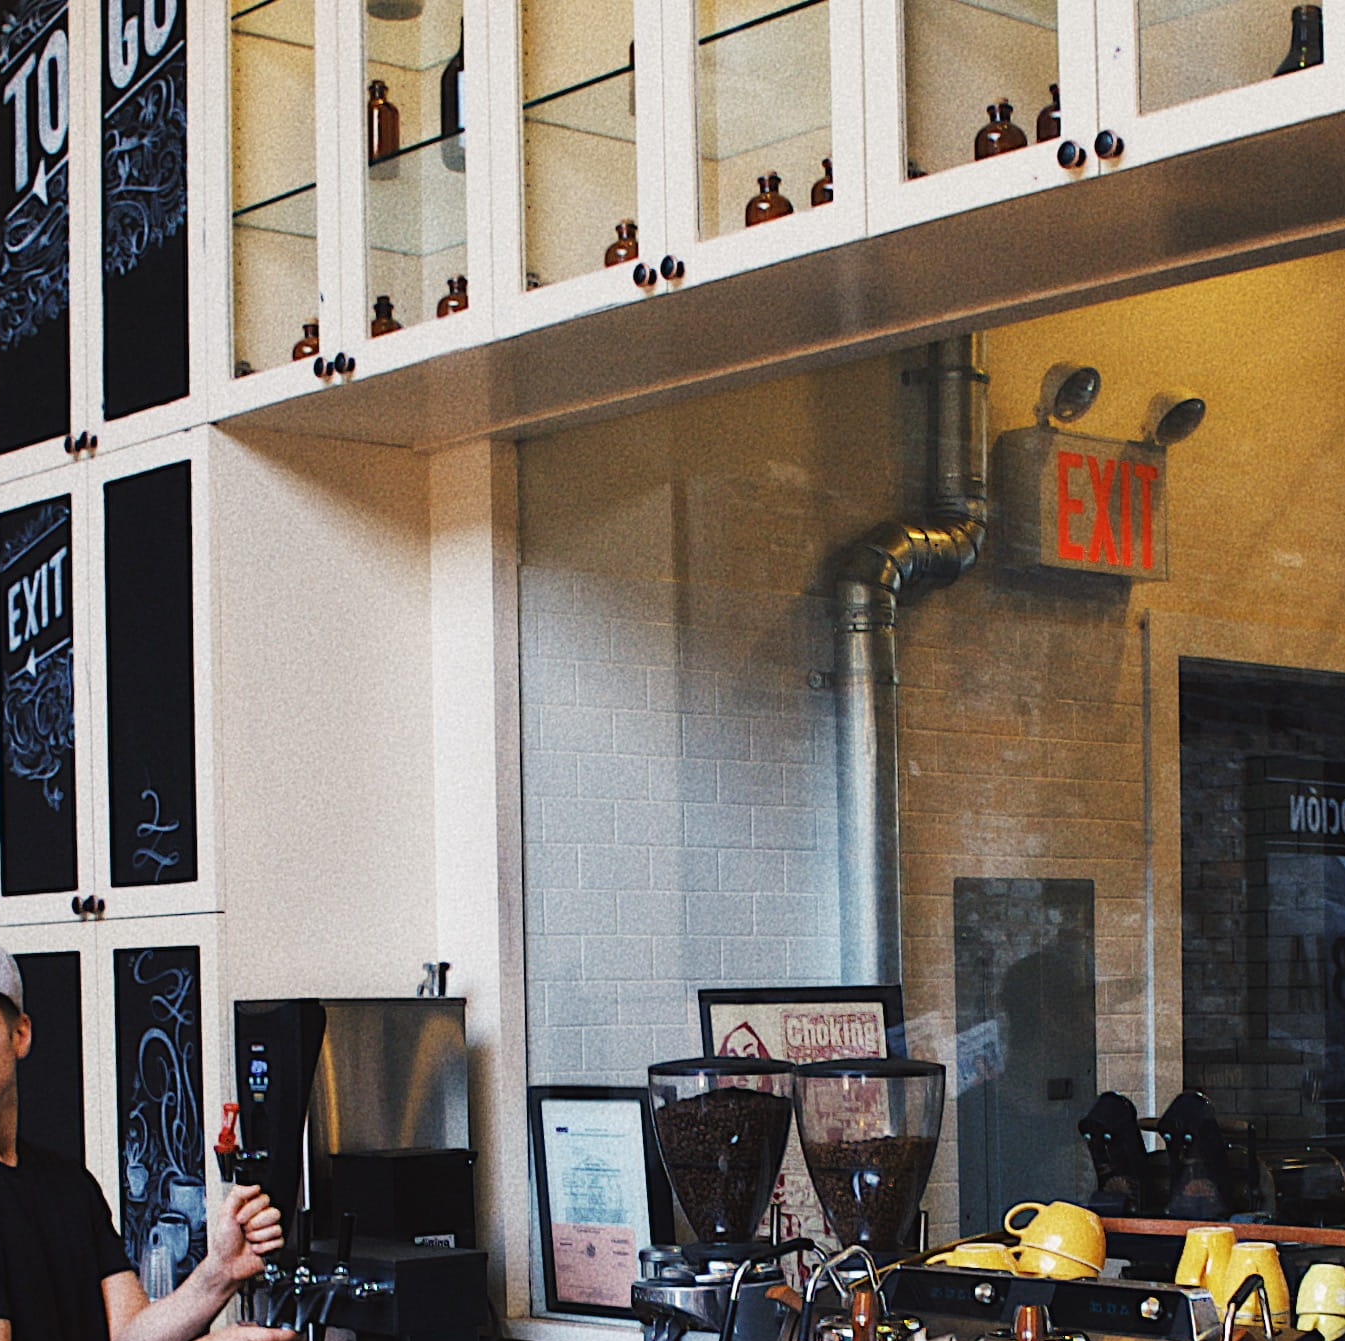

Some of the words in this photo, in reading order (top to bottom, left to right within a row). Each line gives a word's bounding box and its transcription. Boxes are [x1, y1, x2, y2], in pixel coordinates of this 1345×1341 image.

[3, 29, 68, 192] TO
[1057, 451, 1157, 570] EXIT
[7, 547, 67, 653] EXIT
